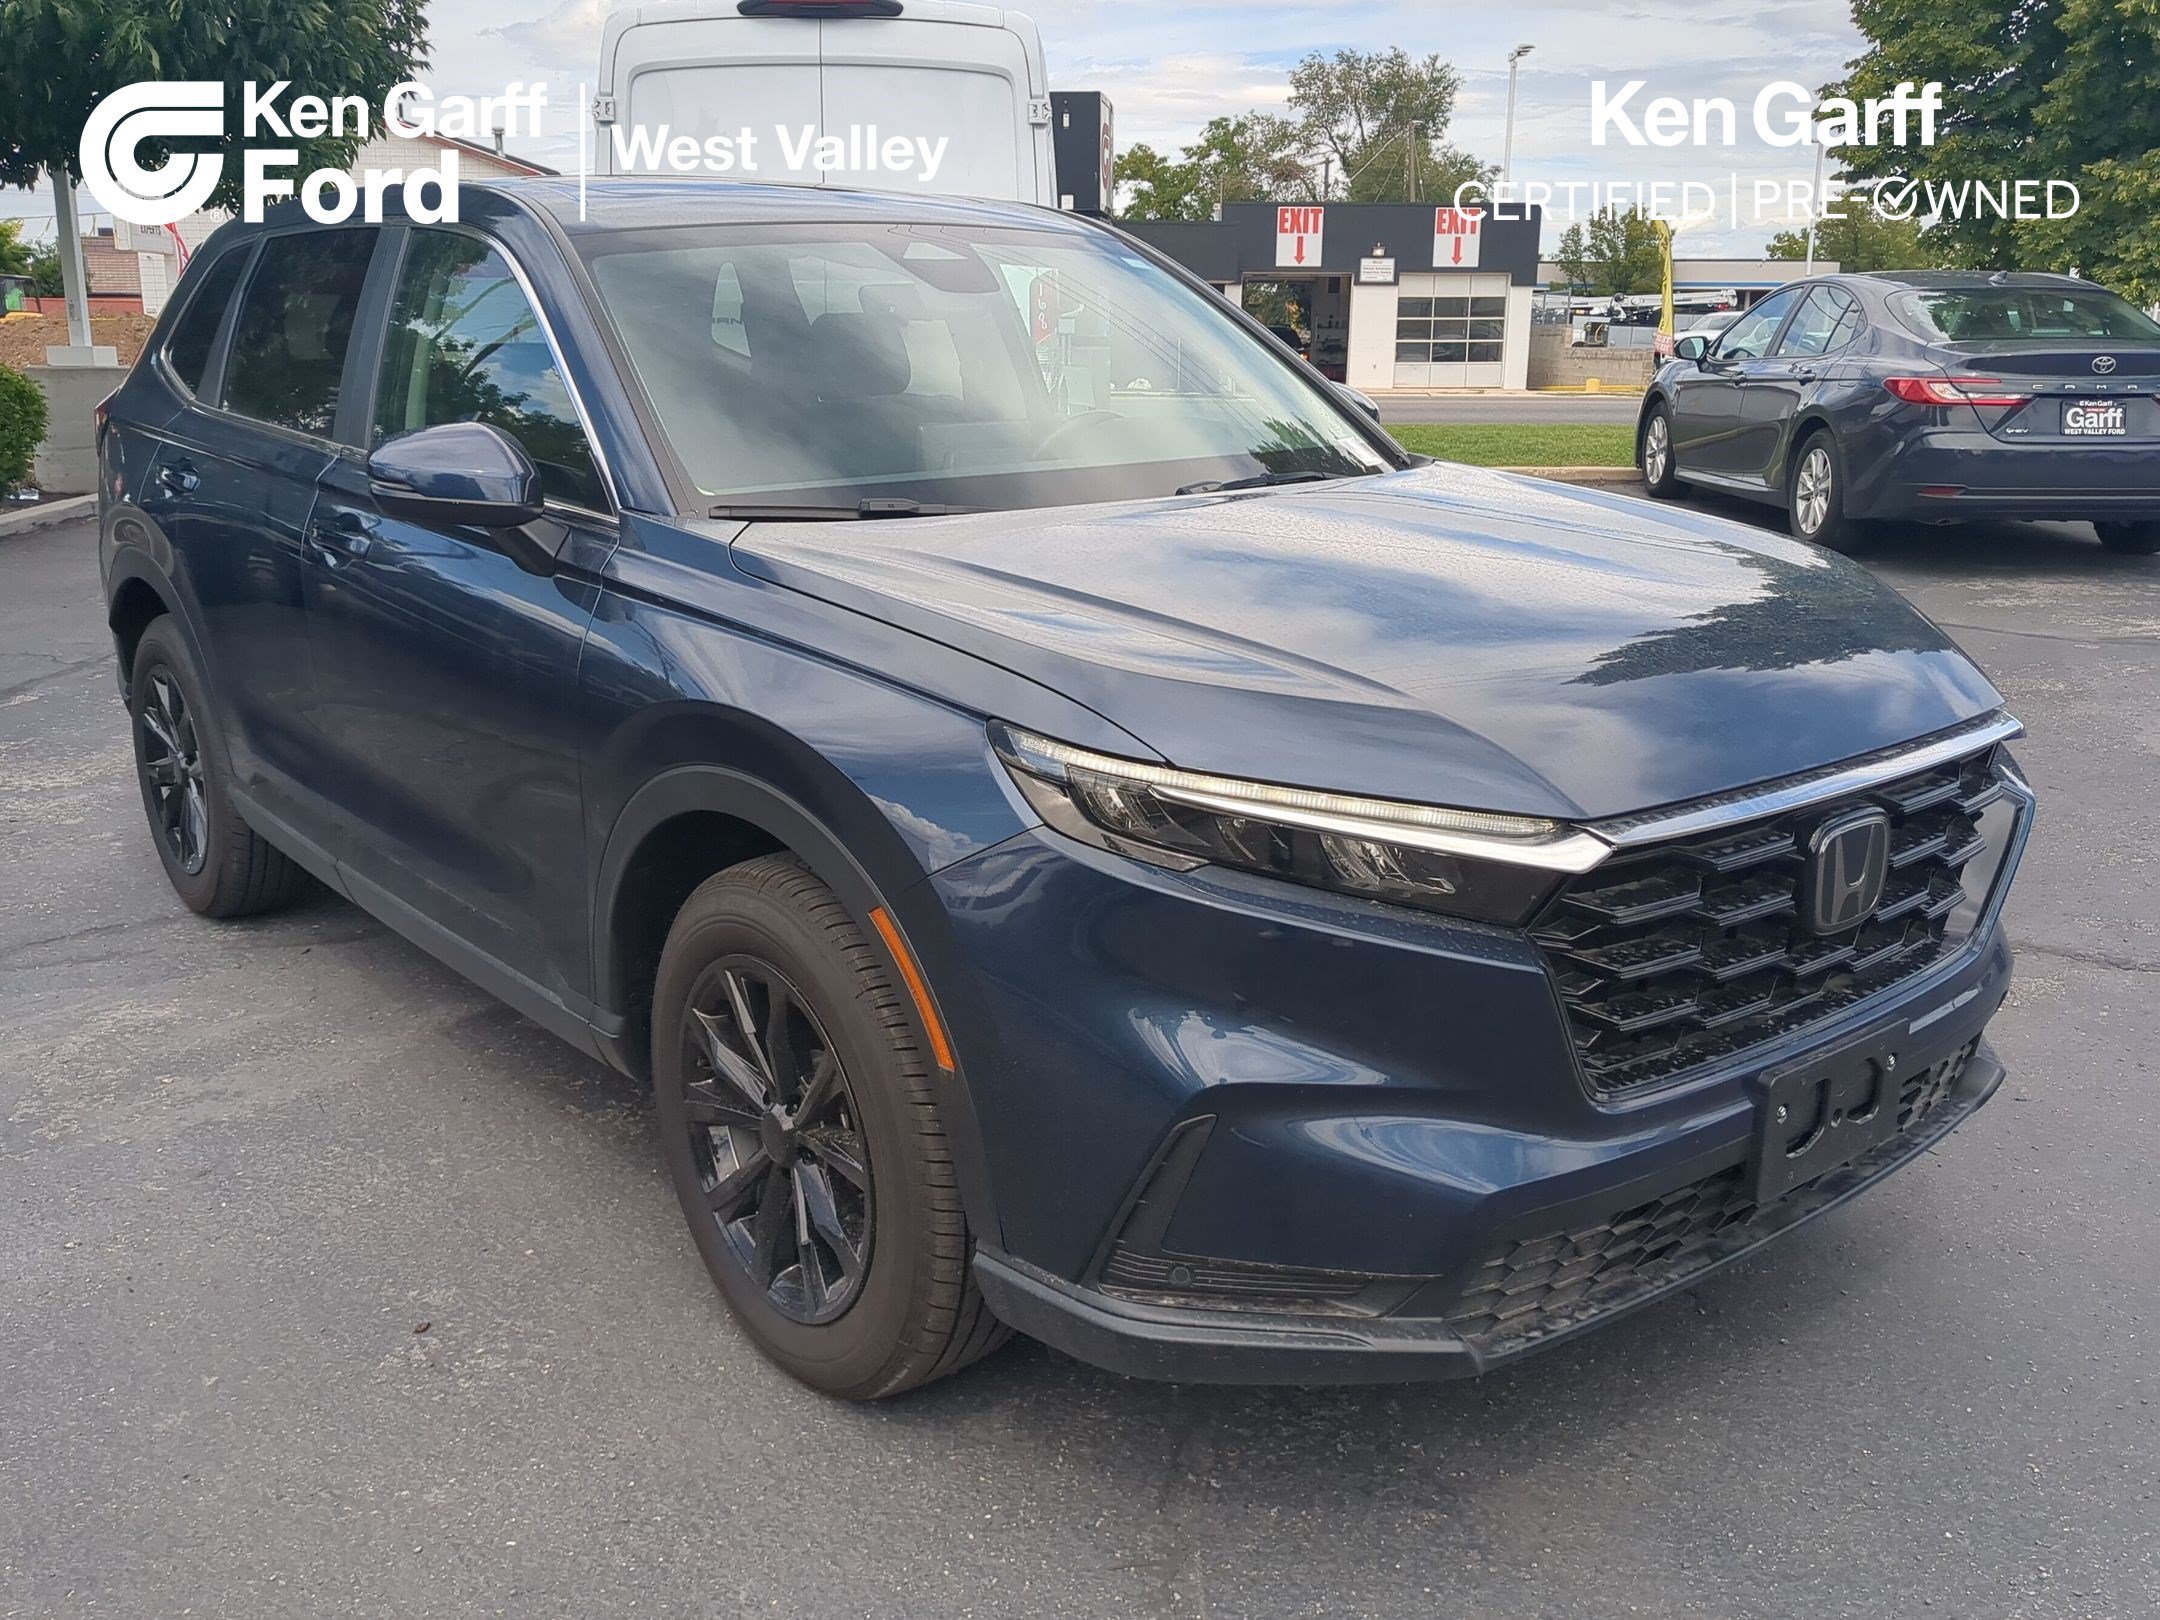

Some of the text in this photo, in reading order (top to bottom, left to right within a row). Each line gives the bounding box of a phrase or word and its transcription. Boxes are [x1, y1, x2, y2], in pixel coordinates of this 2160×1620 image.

[1279, 208, 1322, 233] EXIT
[1436, 209, 1481, 234] EXIT
[2066, 407, 2123, 428] Garff
